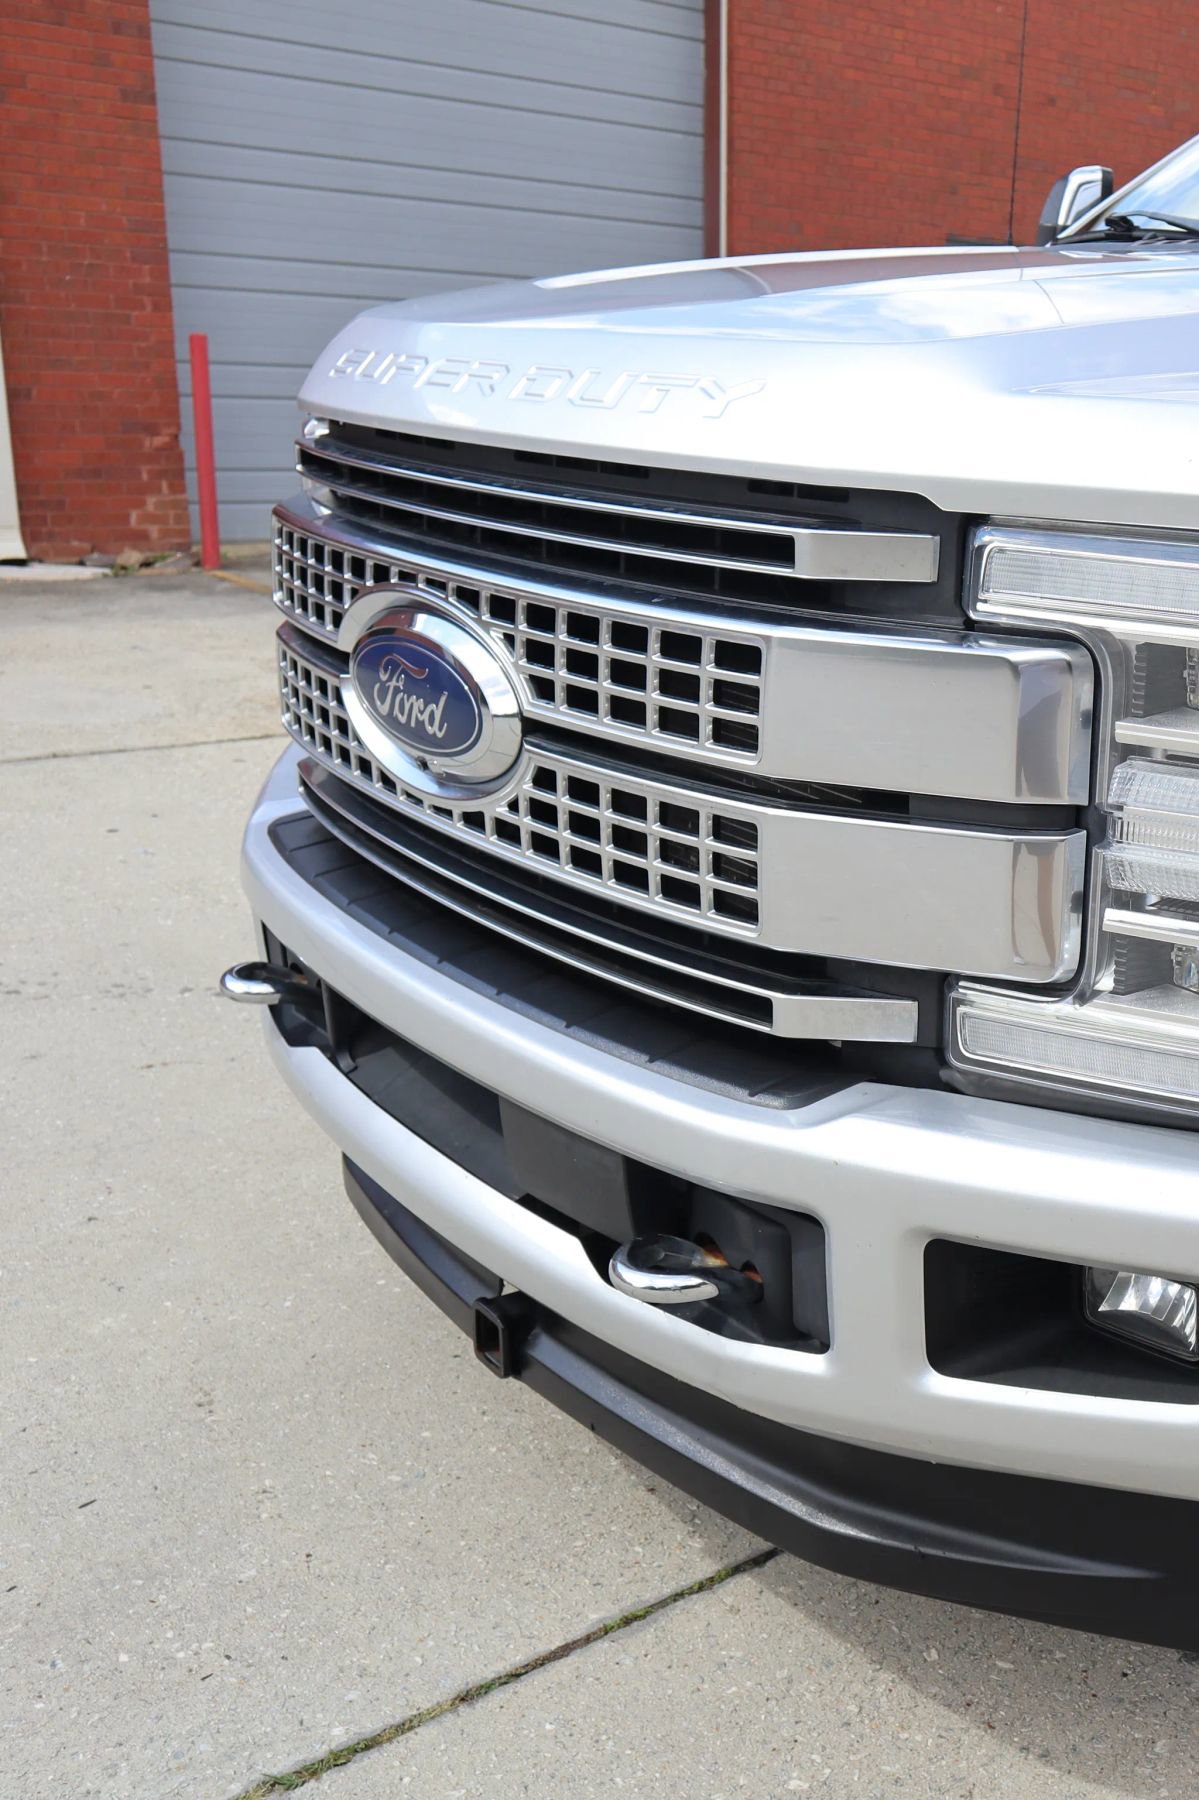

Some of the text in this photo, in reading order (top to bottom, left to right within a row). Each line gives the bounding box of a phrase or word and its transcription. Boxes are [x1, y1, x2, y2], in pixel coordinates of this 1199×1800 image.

[329, 348, 768, 419] SUPER DUTY
[373, 653, 449, 739] Ford
